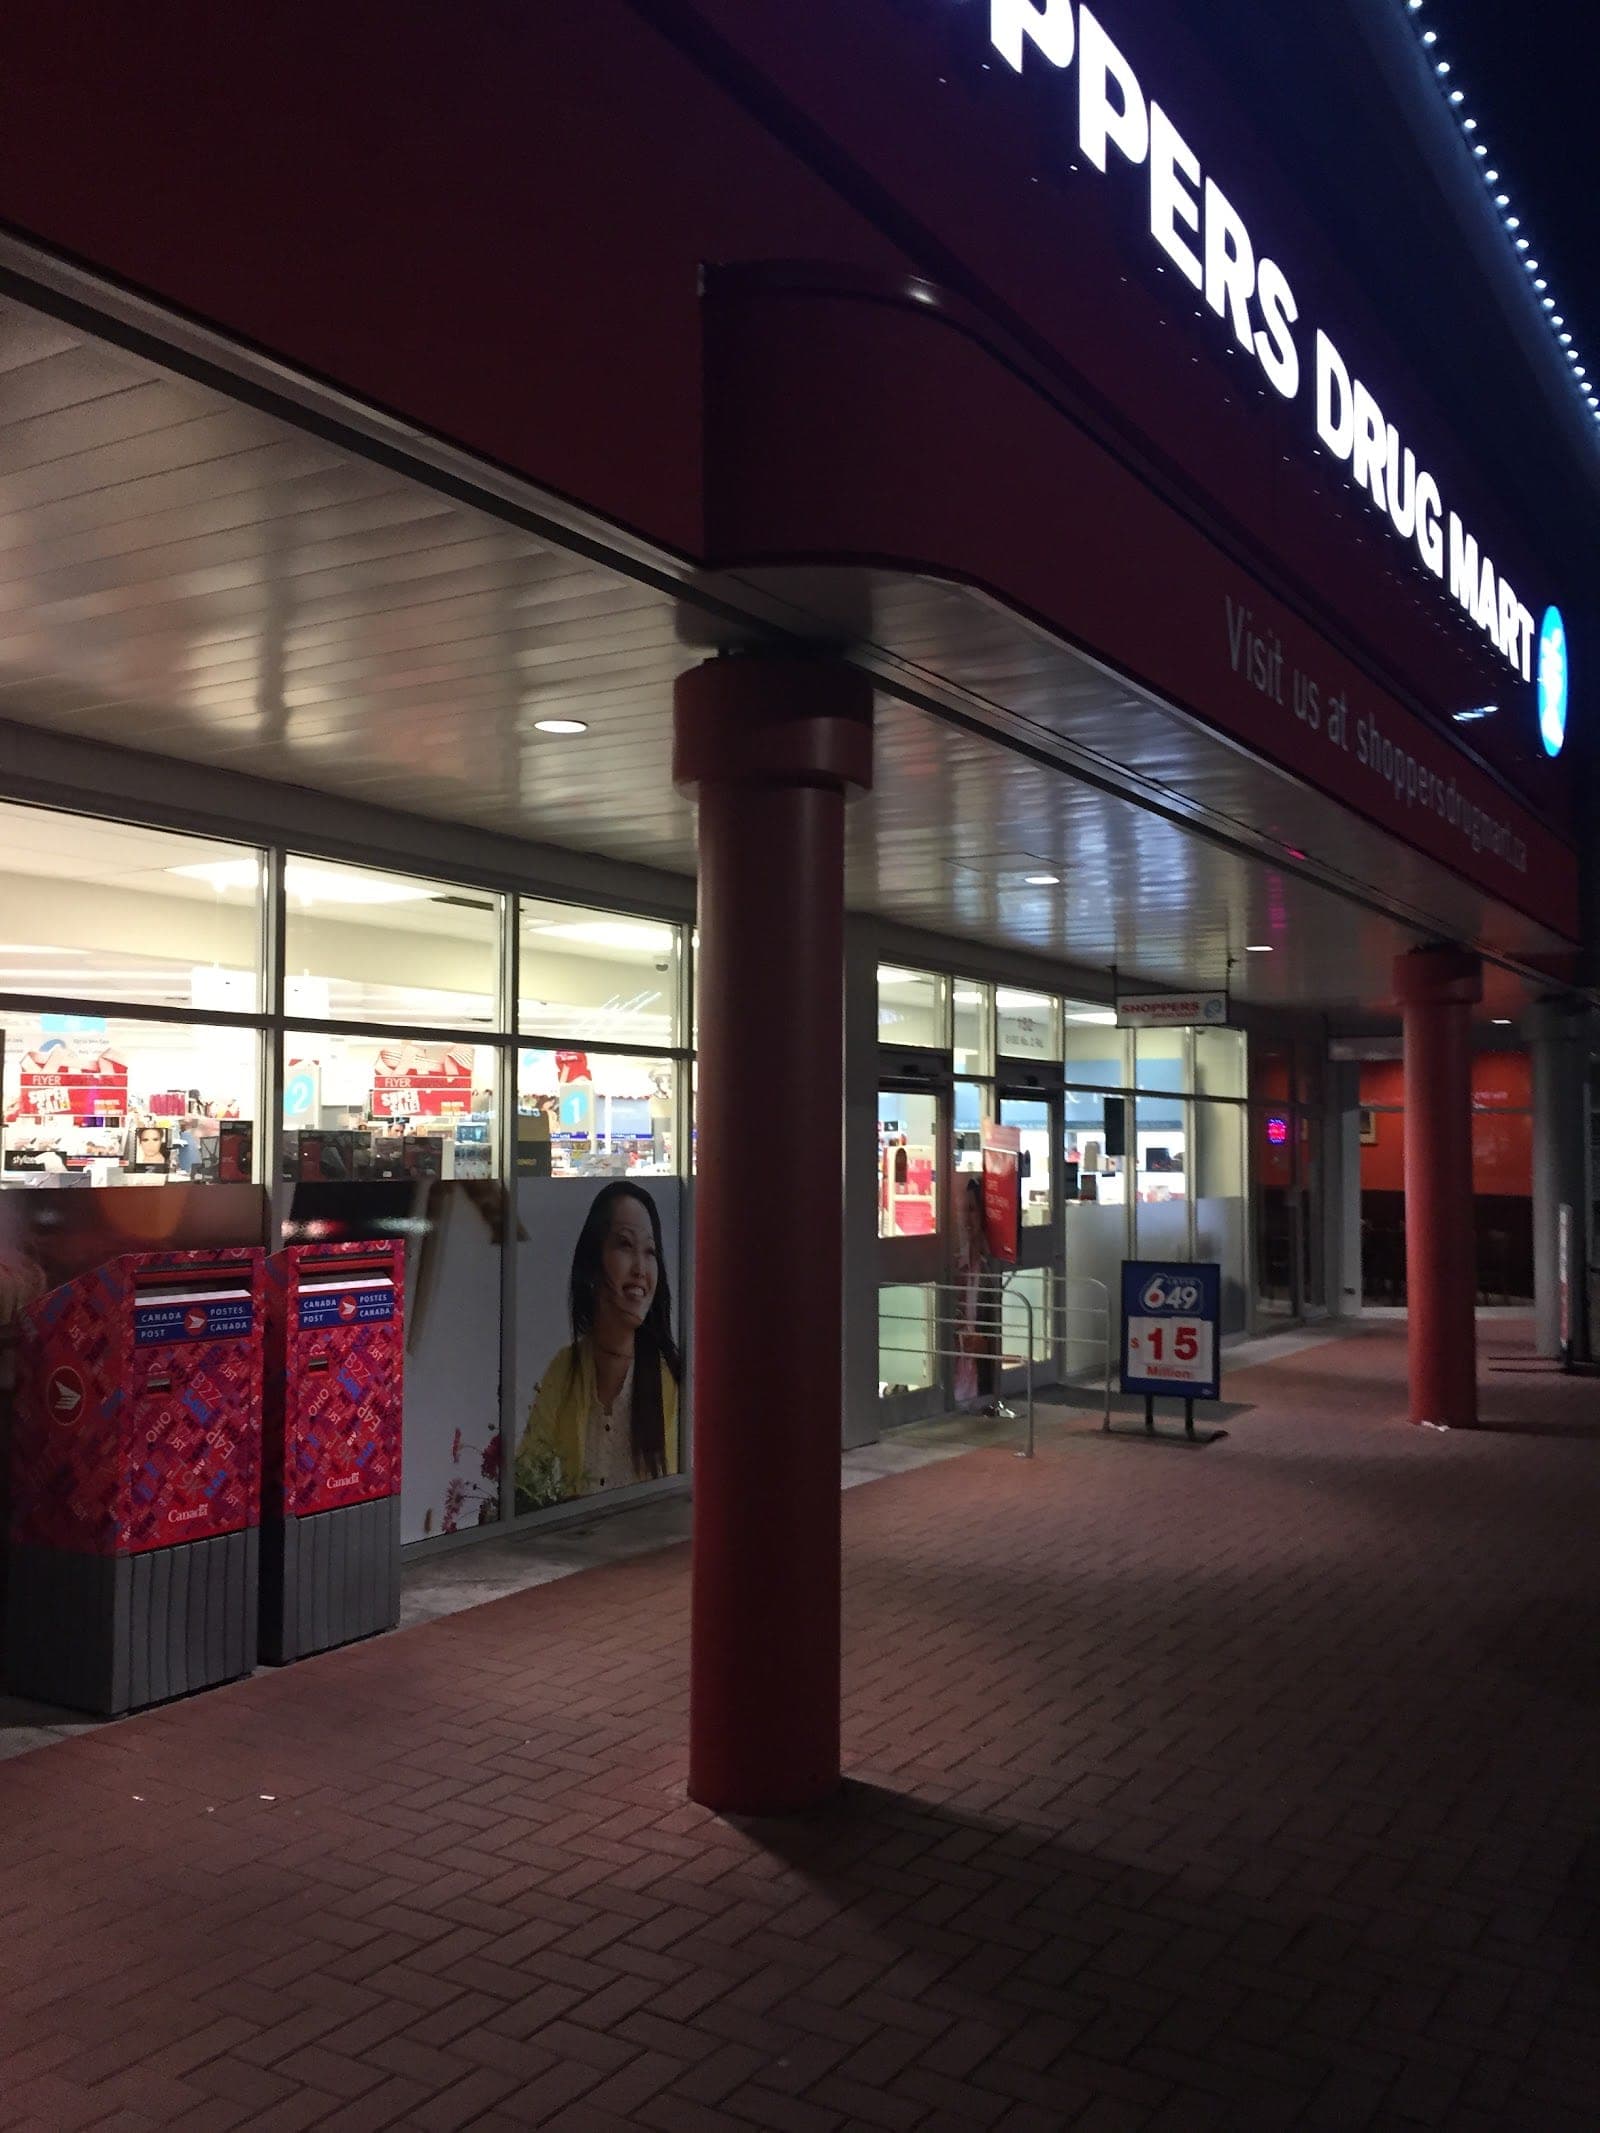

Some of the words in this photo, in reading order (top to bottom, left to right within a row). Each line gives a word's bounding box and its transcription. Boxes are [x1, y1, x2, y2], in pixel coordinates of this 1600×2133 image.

[1316, 329, 1443, 579] DRUG
[1449, 511, 1535, 683] MART
[1225, 595, 1284, 706] Visit
[1293, 668, 1320, 730] us
[1328, 688, 1349, 751] at
[1120, 1001, 1200, 1014] SHOPPERS
[32, 1075, 61, 1086] FLYER
[385, 1078, 412, 1088] FLYER
[292, 1081, 308, 1112] 2
[572, 1098, 581, 1123] 1
[303, 1299, 337, 1310] CANADA
[359, 1294, 387, 1304] POSTES
[1144, 1279, 1198, 1310] 649
[141, 1311, 182, 1323] CANADA
[210, 1306, 244, 1317] POSTES
[303, 1314, 323, 1324] POST
[359, 1307, 390, 1318] CANADA
[141, 1328, 165, 1339] POST
[210, 1321, 247, 1333] CANADA
[1130, 1337, 1140, 1349] $
[1147, 1327, 1199, 1361] 15
[1147, 1366, 1191, 1379] Million
[190, 1371, 223, 1408] B2Z
[326, 1471, 360, 1489] Canada
[168, 1503, 208, 1523] Canada
